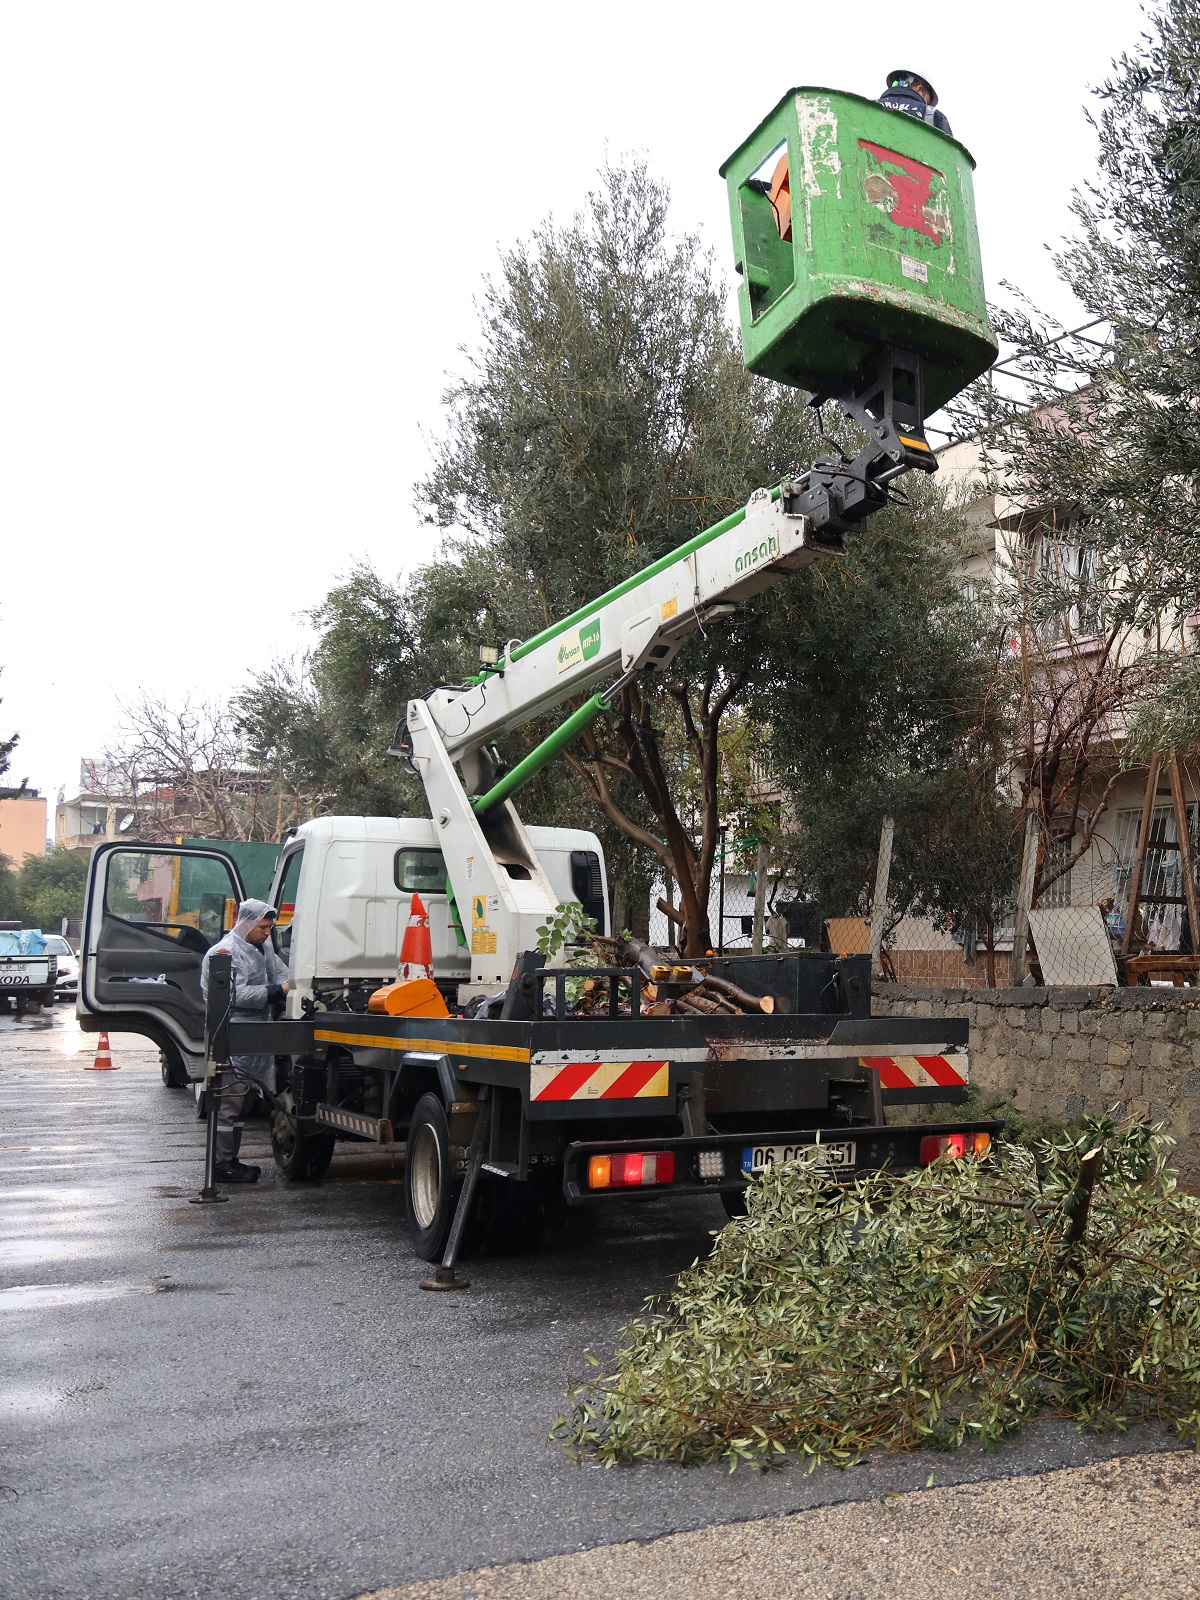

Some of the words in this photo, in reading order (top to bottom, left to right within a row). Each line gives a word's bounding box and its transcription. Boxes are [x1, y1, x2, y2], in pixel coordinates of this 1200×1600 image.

[735, 537, 777, 573] ansan
[0, 975, 30, 984] KODA
[754, 1147, 775, 1168] 06
